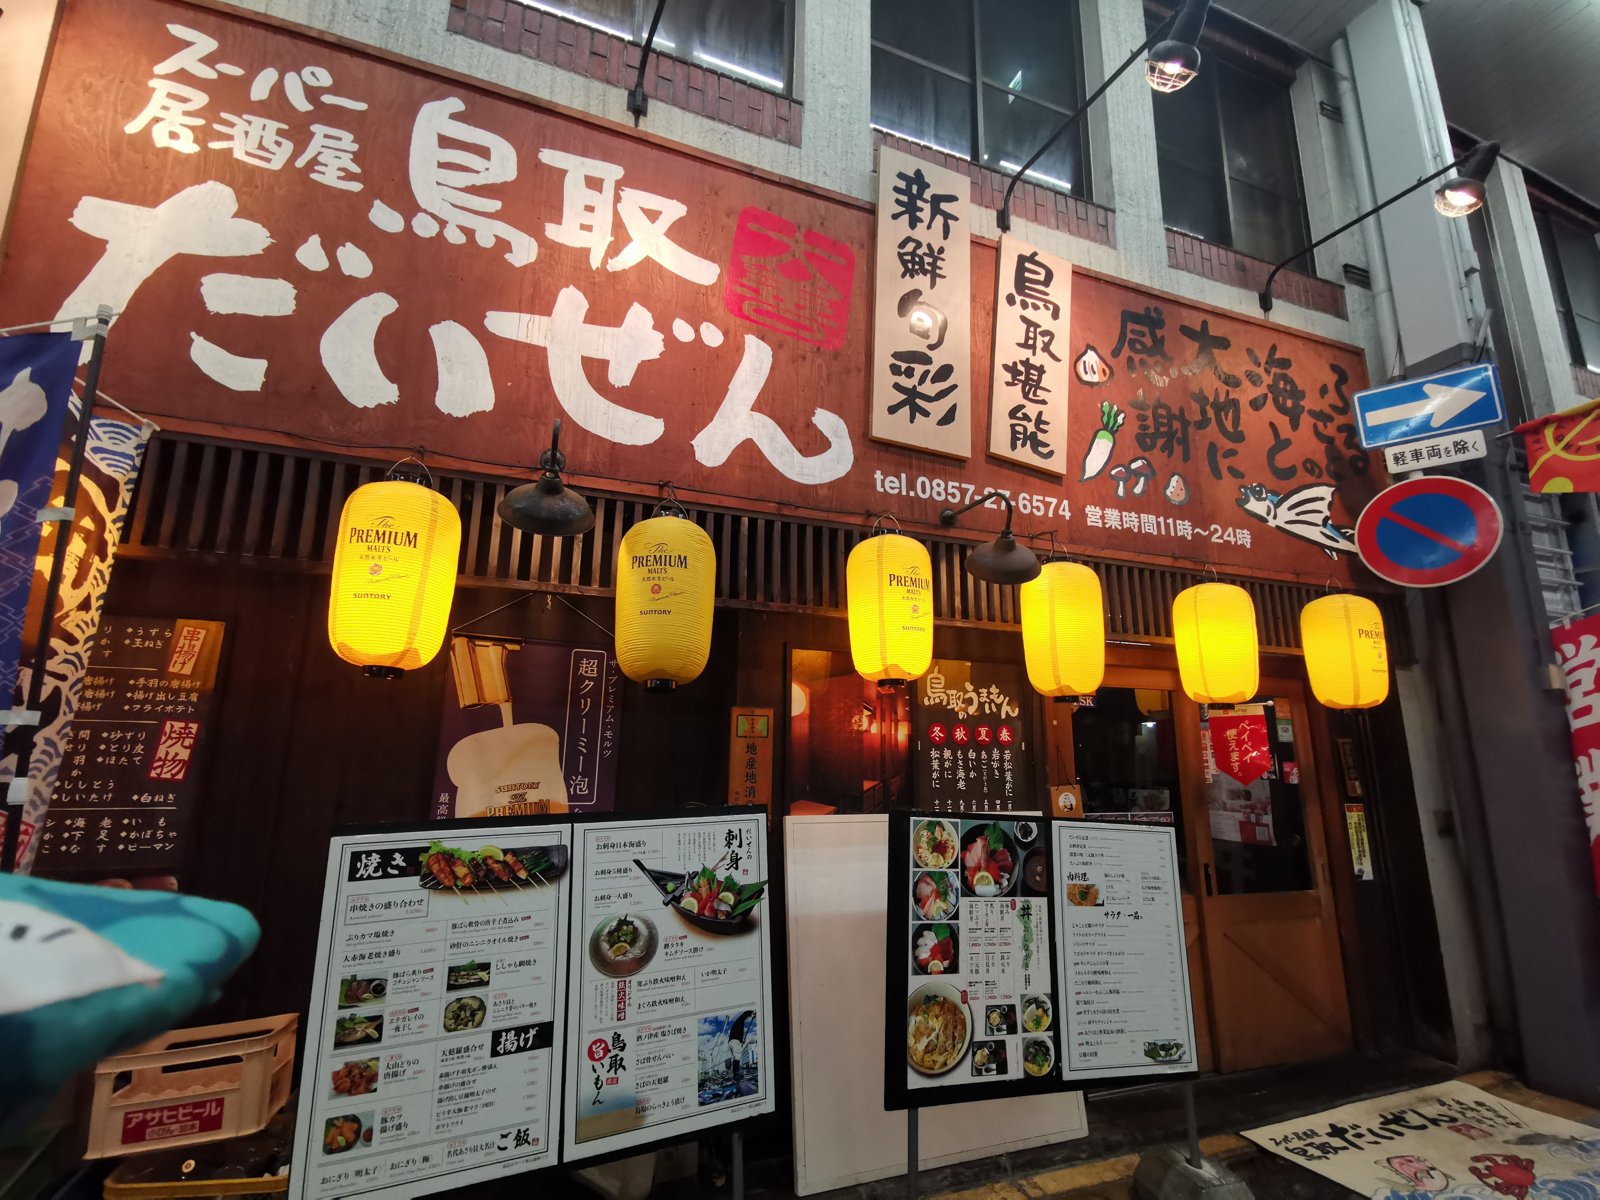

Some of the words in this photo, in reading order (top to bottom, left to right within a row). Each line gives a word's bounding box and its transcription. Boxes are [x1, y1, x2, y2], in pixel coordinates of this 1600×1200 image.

[153, 23, 368, 111] スーパー
[124, 78, 365, 192] 居酒屋
[369, 96, 720, 285] 鳥取
[887, 168, 960, 427] 新鮮旬彩
[50, 180, 853, 485] だいぜん
[1002, 251, 1063, 460] 鳥取堪能
[1111, 306, 1192, 463] 感謝
[1178, 320, 1246, 480] 大地に
[1391, 439, 1478, 466] 軽車両を除く
[349, 527, 419, 549] PREMIUM
[631, 554, 688, 569] PREMIUM
[353, 592, 391, 600] SUNTORY
[570, 658, 598, 795] 超クリーミー泡
[931, 727, 945, 741] 冬
[954, 727, 967, 741] 秋
[977, 727, 990, 741] 夏
[1000, 727, 1012, 742] 春
[1239, 720, 1253, 763] ペイペイ
[151, 722, 197, 779] 焼物
[930, 747, 940, 788] 松葉がに
[968, 748, 977, 779] 白いか
[495, 782, 540, 794] SUNTORY
[355, 852, 407, 878] 焼き
[724, 828, 743, 871] 刺身
[350, 898, 424, 913] 串焼きの盛り合わせ
[497, 1026, 540, 1055] 揚げ
[607, 1031, 627, 1076] 鳥取
[591, 1041, 606, 1106] 旨いもん
[126, 1101, 221, 1129] アサヒビール
[497, 1127, 531, 1151] ご飯
